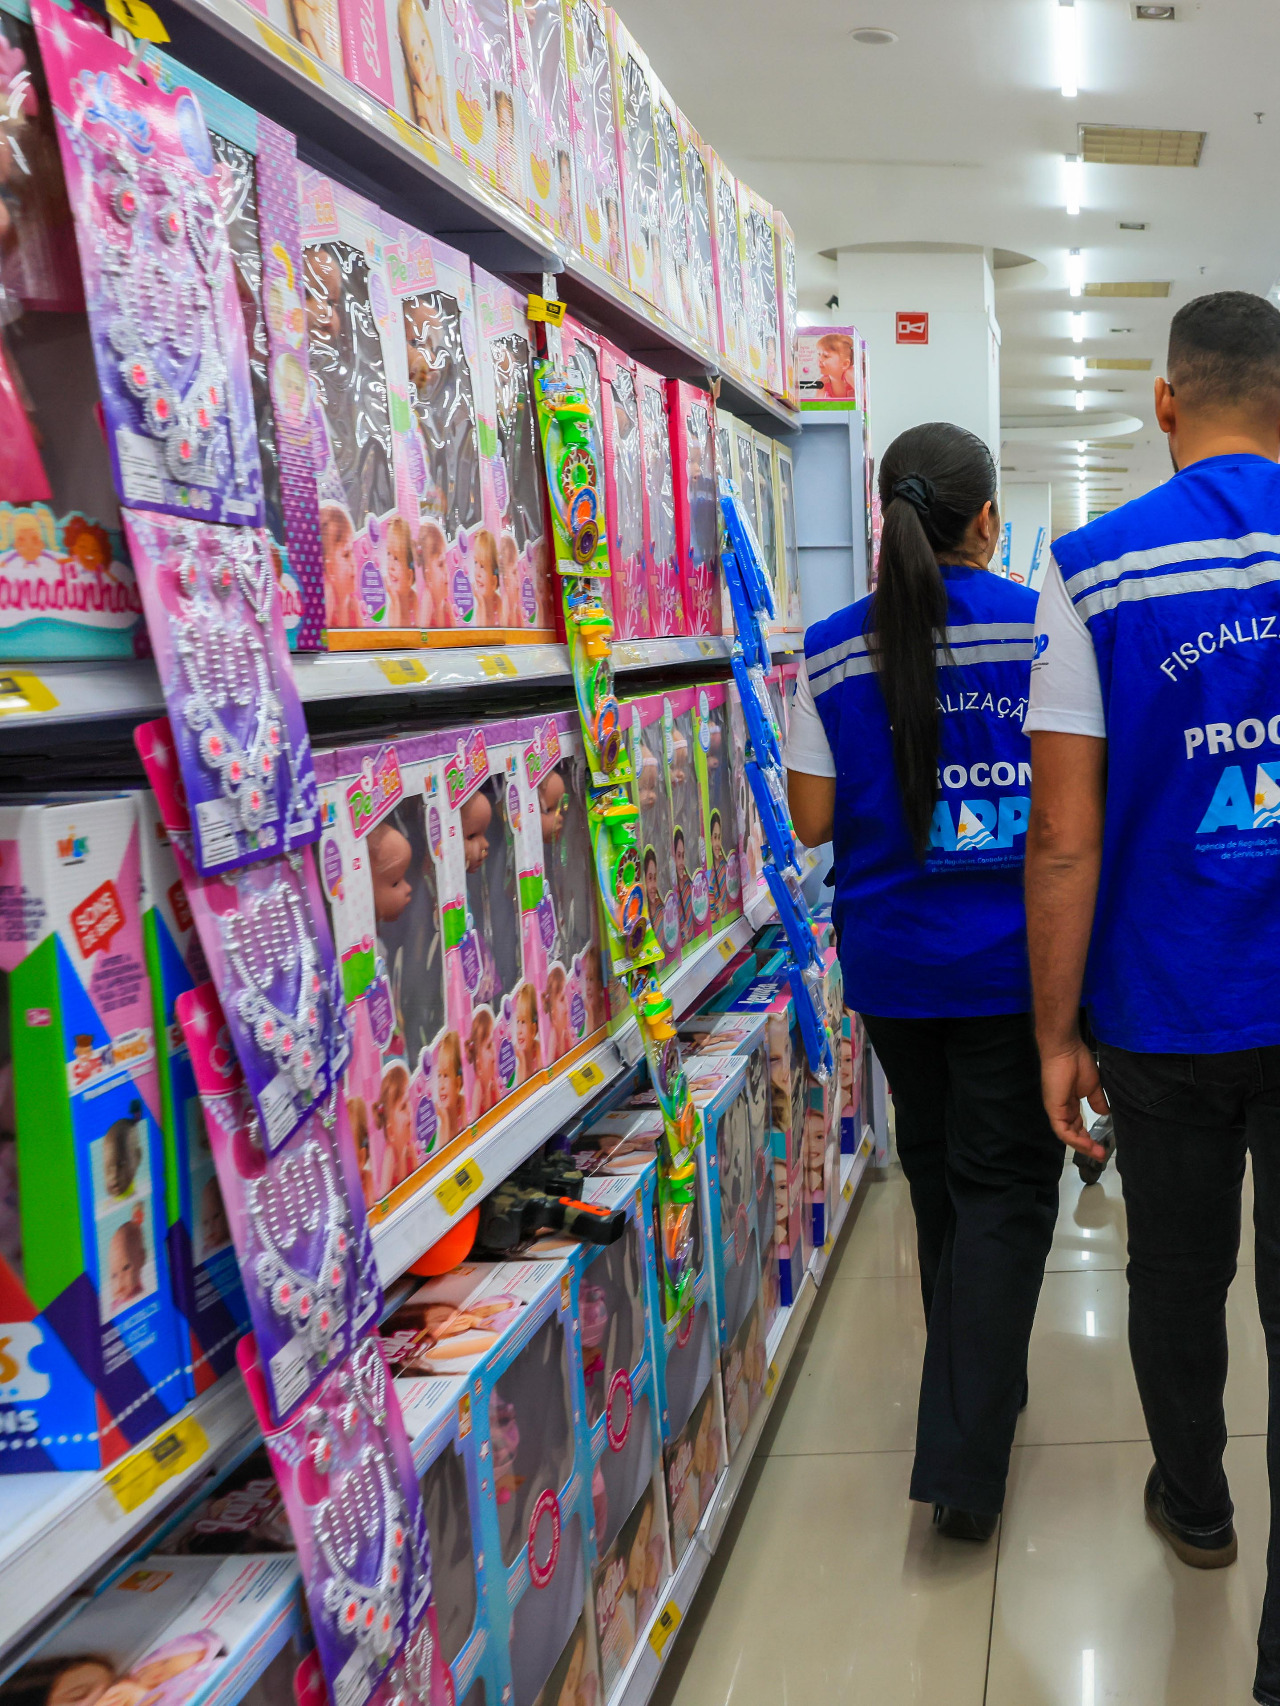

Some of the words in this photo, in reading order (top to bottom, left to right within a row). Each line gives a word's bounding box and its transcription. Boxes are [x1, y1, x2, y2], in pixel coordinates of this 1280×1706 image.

[935, 761, 1033, 789] OCON
[1194, 841, 1226, 852] Agência
[1227, 840, 1237, 849] de
[1220, 851, 1232, 860] de
